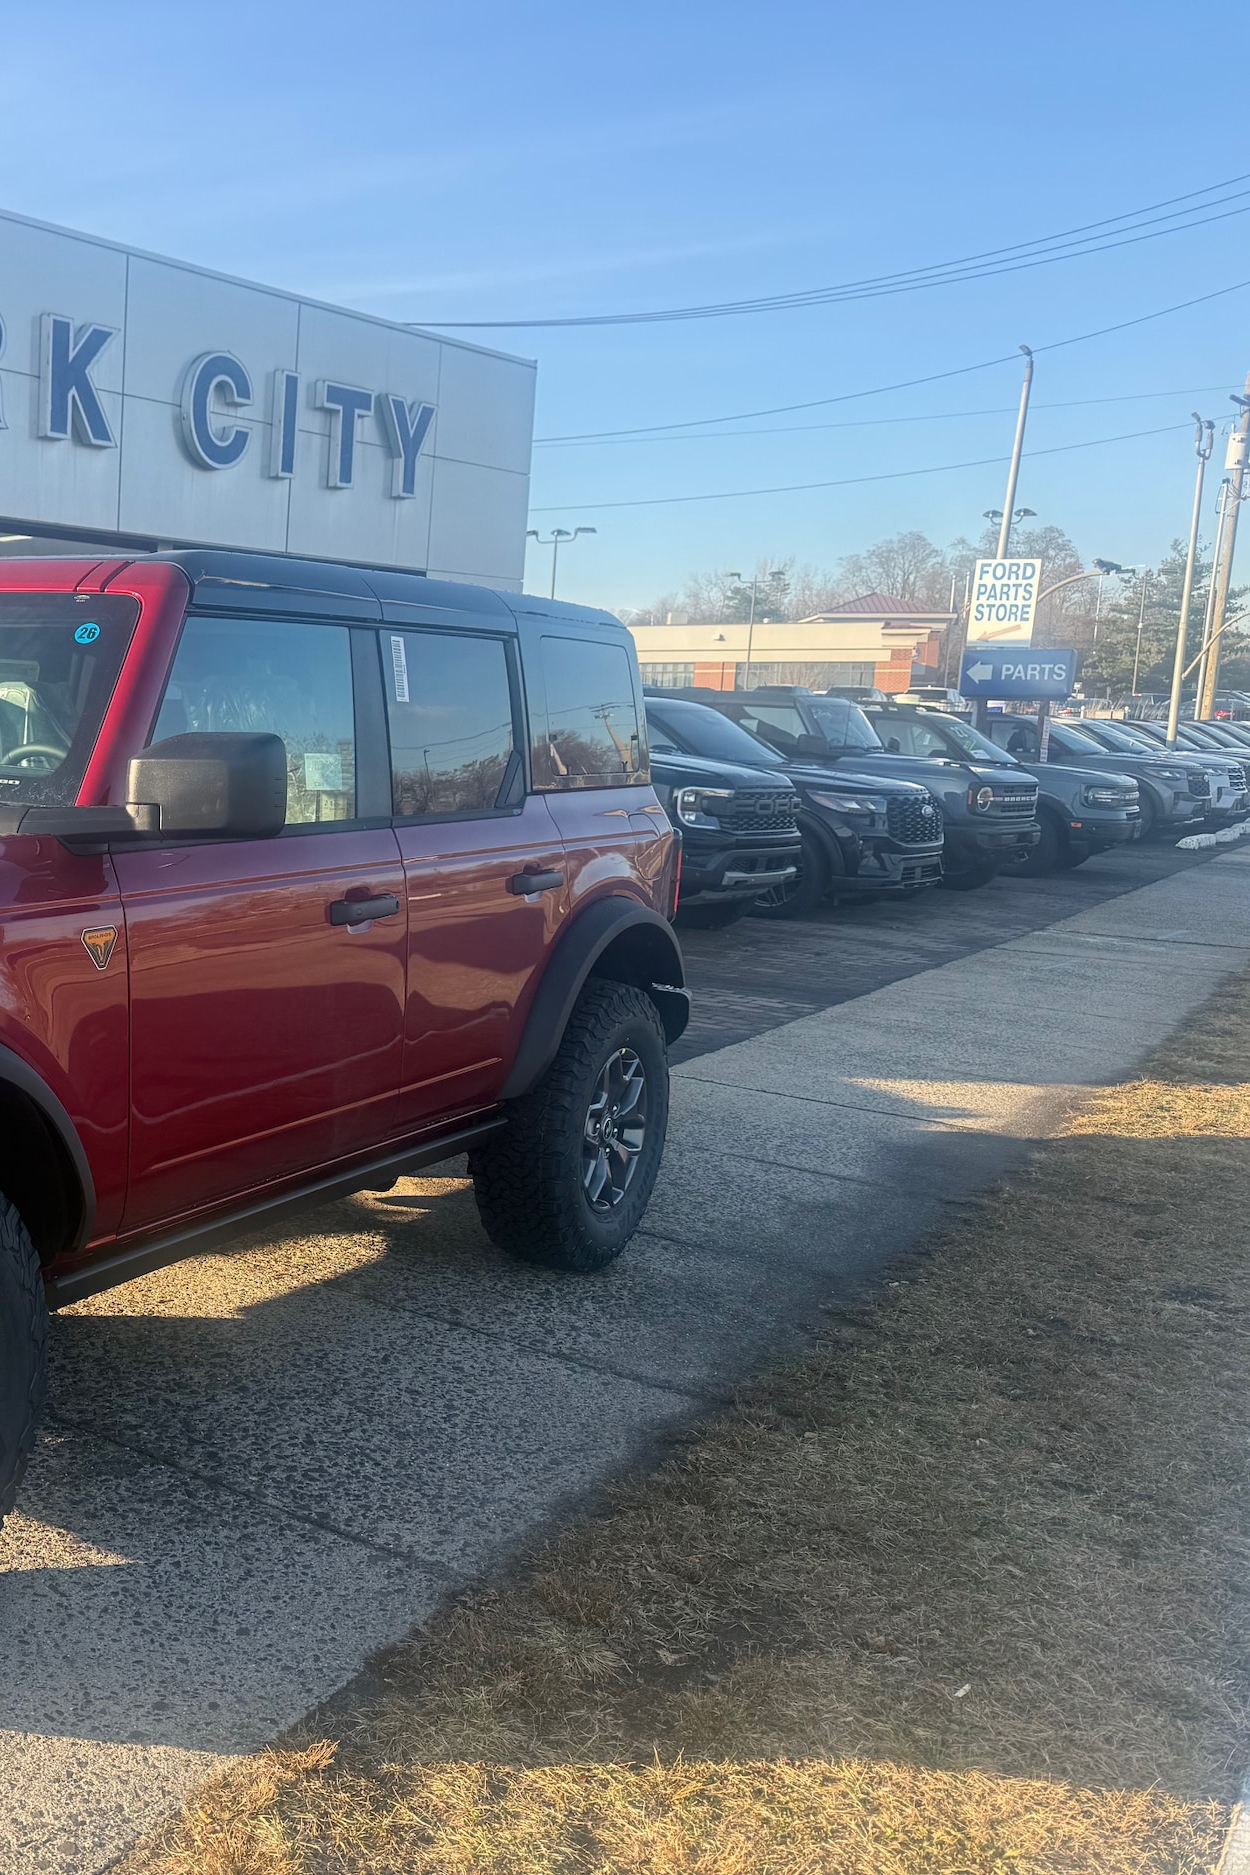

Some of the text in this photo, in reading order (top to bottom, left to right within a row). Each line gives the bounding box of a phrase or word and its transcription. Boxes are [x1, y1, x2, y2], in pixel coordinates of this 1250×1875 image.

[181, 350, 438, 499] CITY
[979, 562, 1036, 581] FORD
[976, 583, 1034, 602] PARTS
[974, 603, 1032, 622] STORE
[77, 627, 98, 640] 26
[1001, 663, 1067, 681] PARTS
[731, 797, 802, 815] FORD
